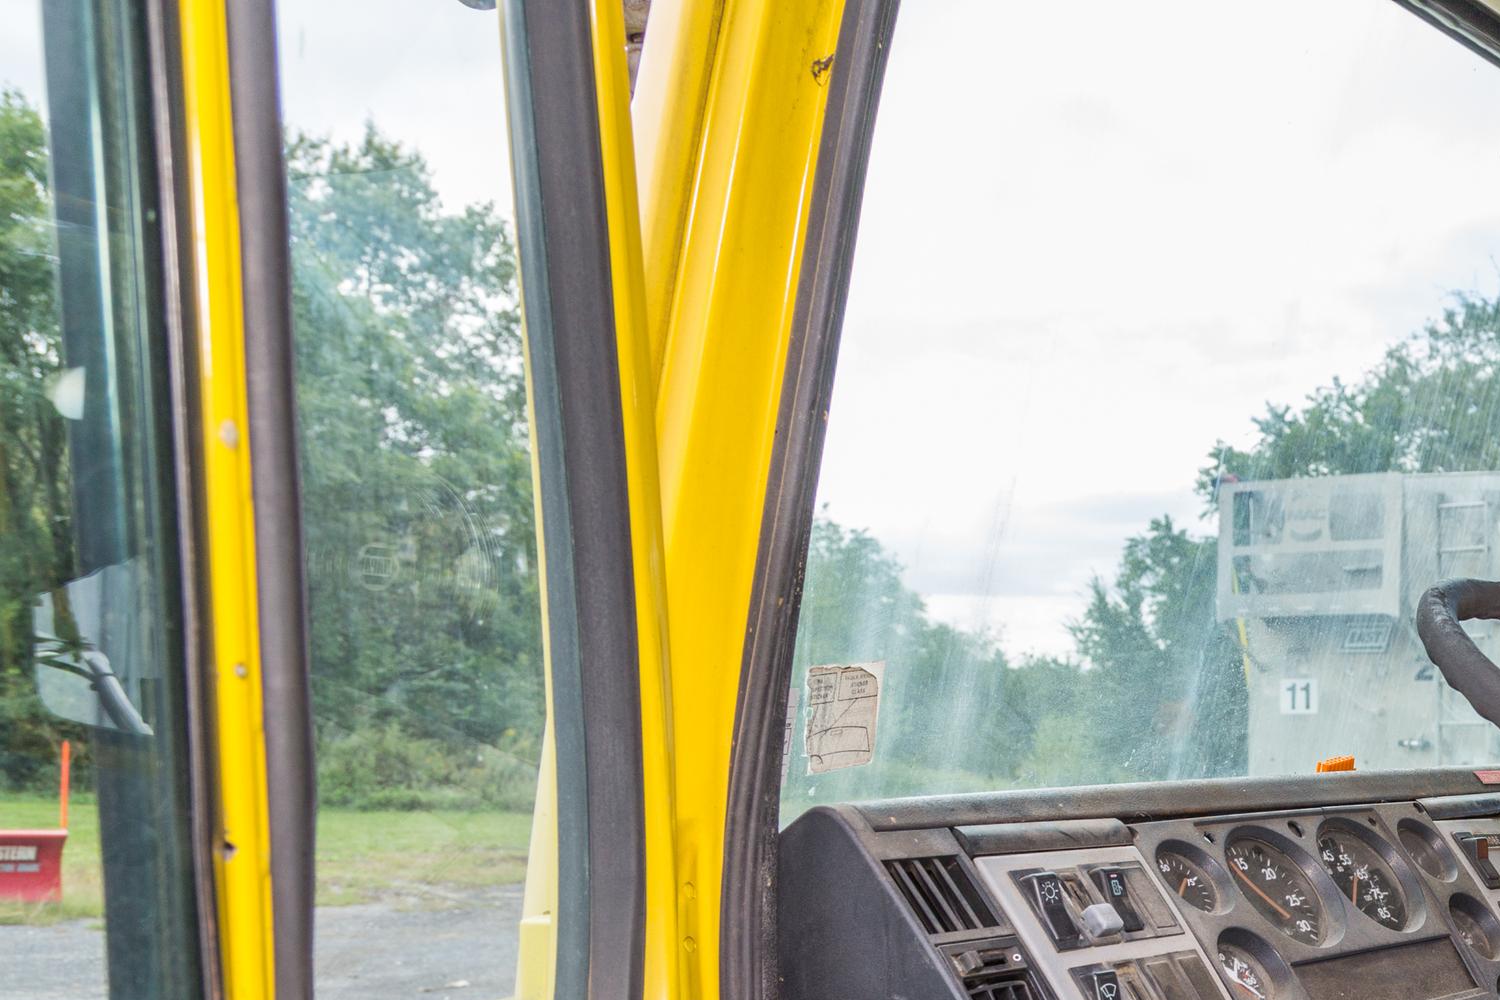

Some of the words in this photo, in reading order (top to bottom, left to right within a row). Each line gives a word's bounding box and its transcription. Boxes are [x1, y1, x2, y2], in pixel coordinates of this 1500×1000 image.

[1286, 683, 1311, 710] 11
[1322, 849, 1335, 862] 45
[1339, 853, 1352, 866] 55
[1234, 857, 1249, 871] 15
[1261, 867, 1277, 881] 20
[1356, 868, 1369, 880] 65
[1286, 893, 1301, 907] 25
[1370, 887, 1384, 900] 75
[1377, 906, 1391, 919] 85
[1296, 919, 1311, 933] 30
